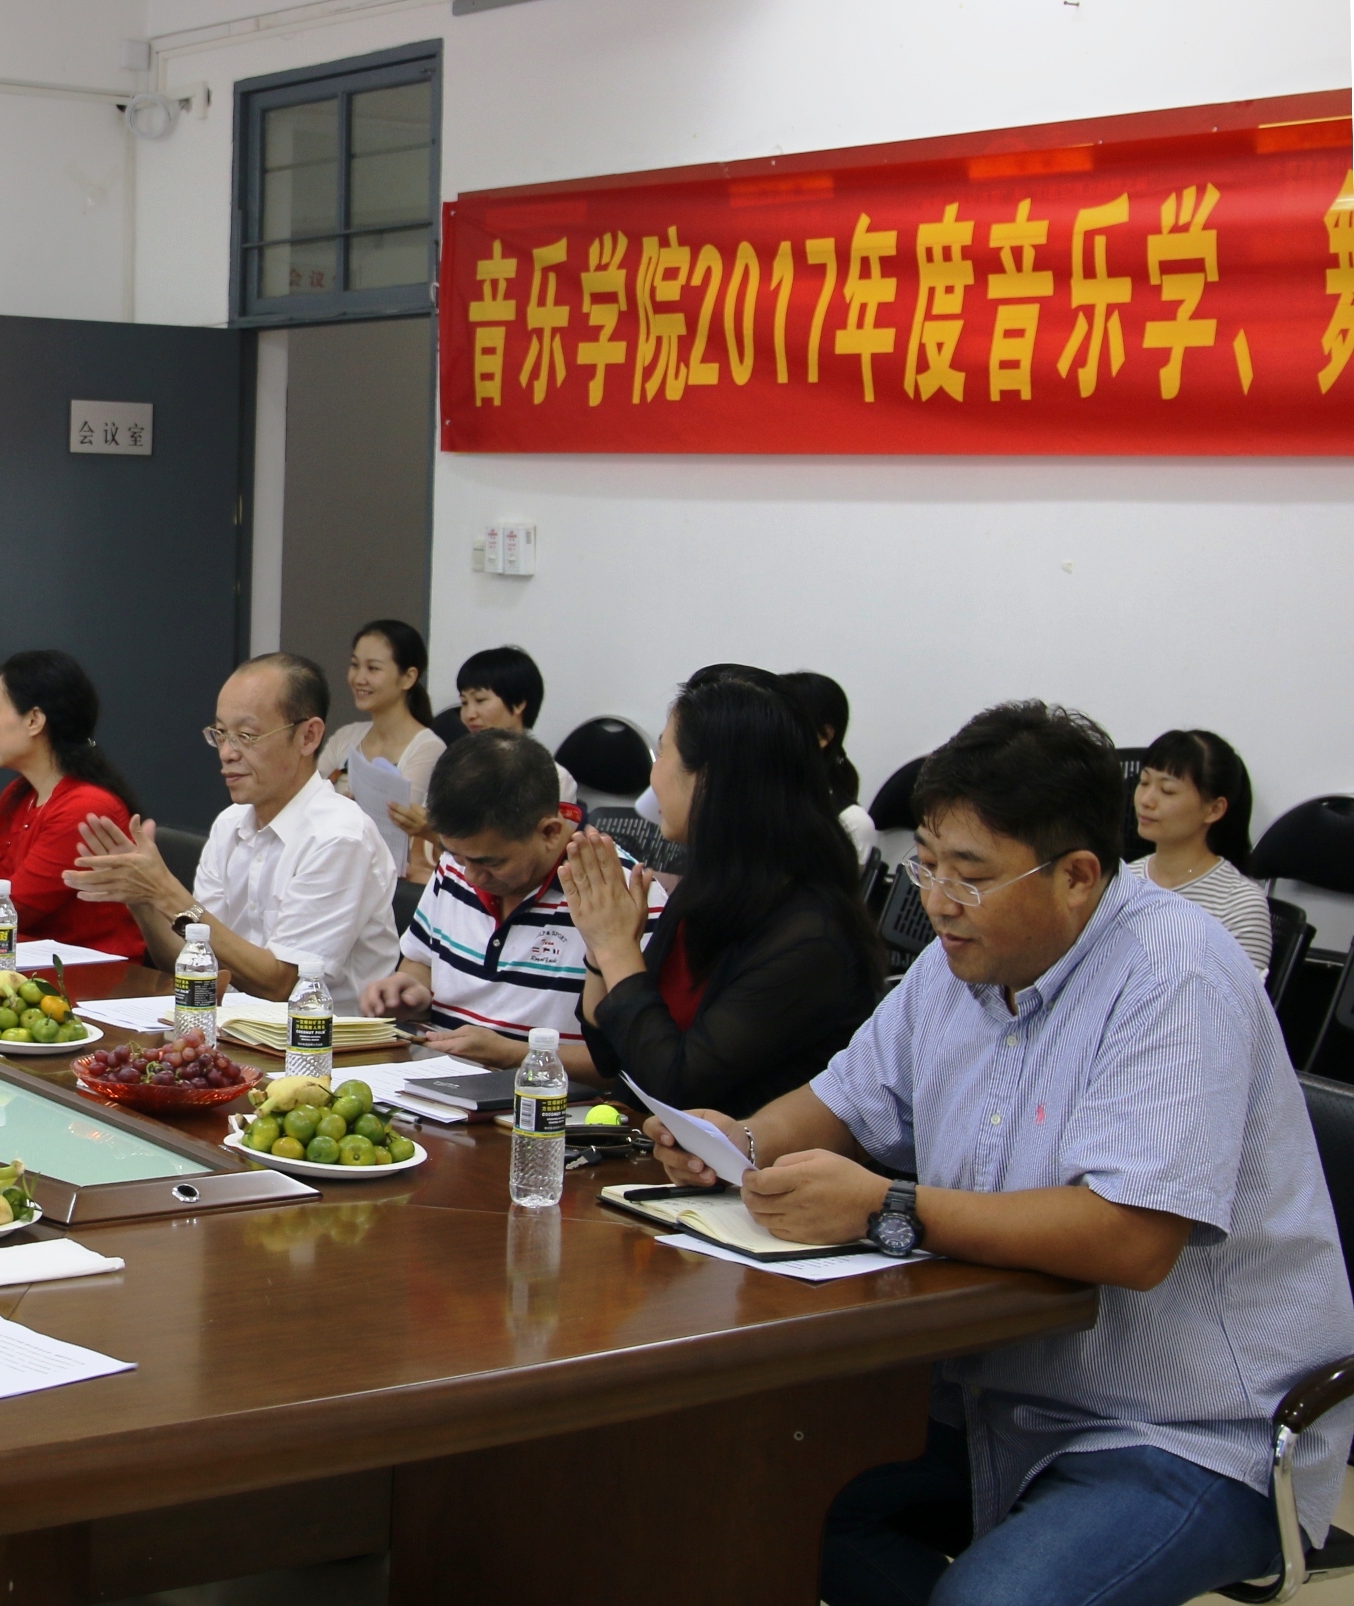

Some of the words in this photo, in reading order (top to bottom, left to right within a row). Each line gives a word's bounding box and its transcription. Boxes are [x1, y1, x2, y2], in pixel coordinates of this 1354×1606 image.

[289, 267, 337, 289] 会议
[77, 419, 145, 448] 会议室
